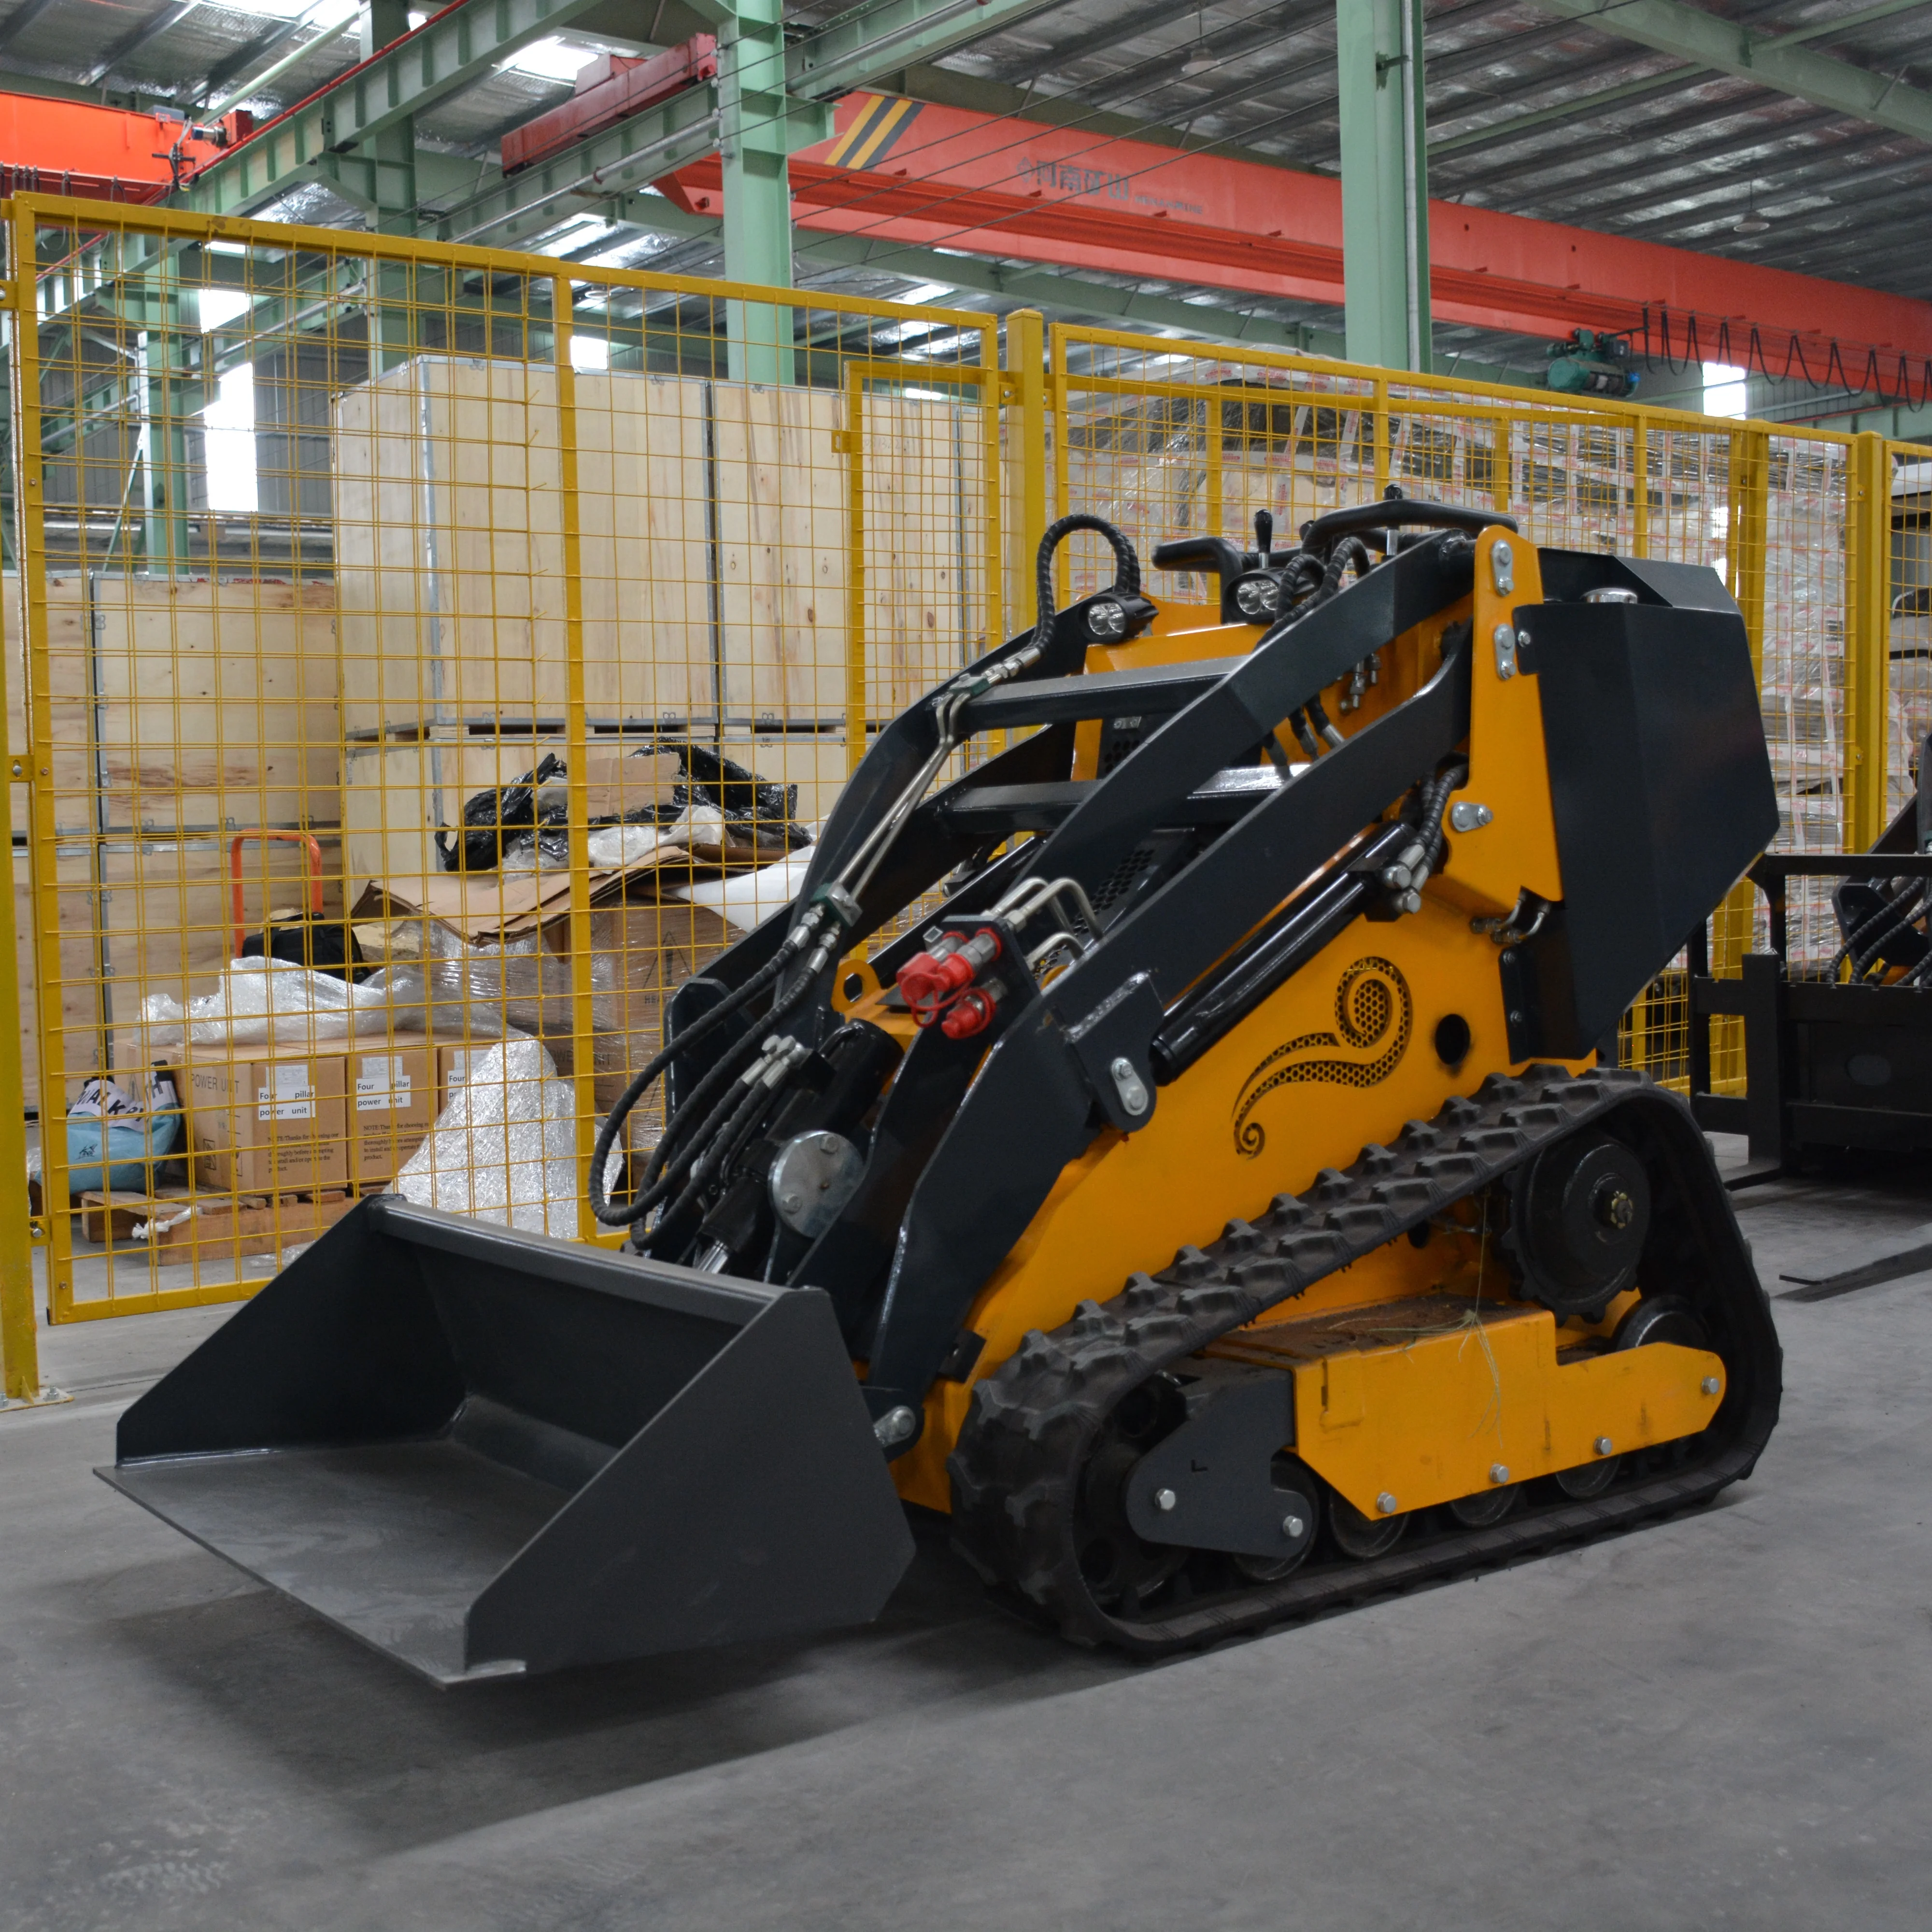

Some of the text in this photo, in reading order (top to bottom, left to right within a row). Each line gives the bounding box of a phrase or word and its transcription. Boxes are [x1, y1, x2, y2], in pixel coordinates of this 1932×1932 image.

[358, 1099, 381, 1108] power
[260, 1106, 307, 1118] poer unit
